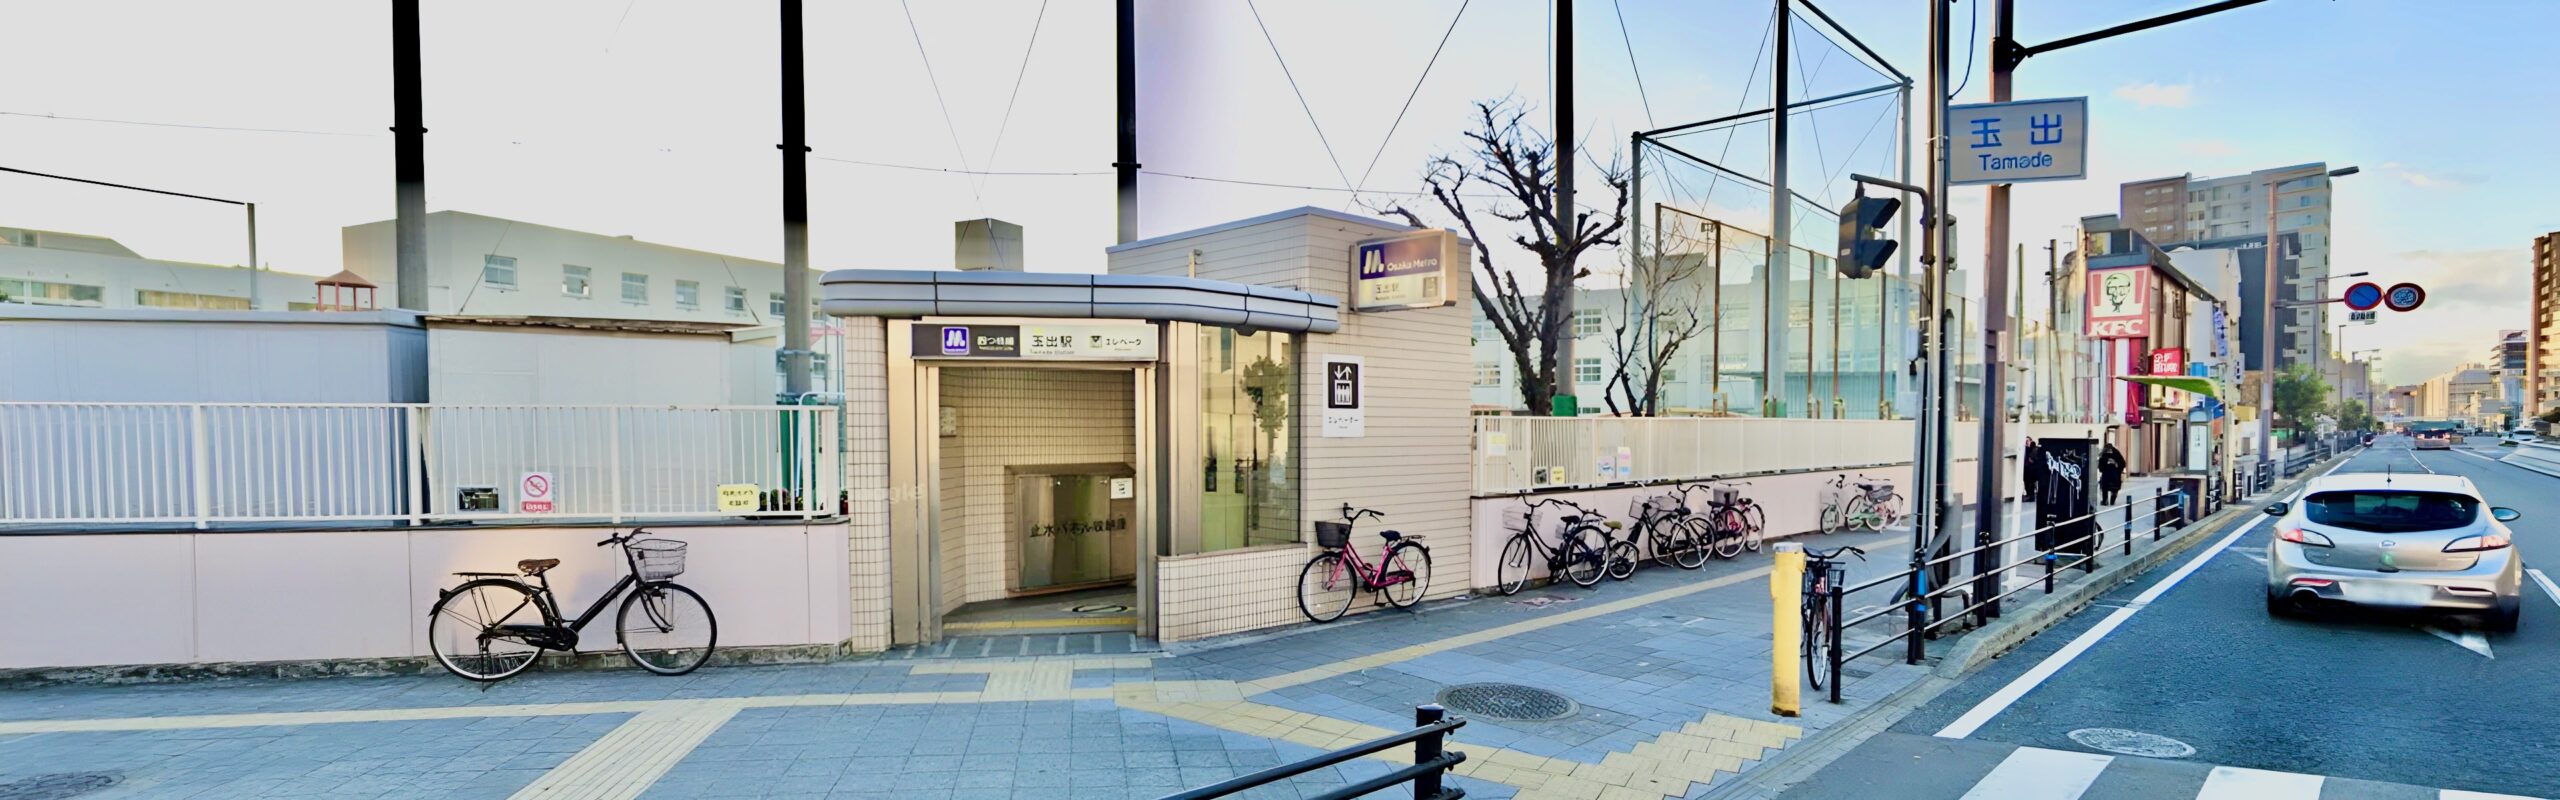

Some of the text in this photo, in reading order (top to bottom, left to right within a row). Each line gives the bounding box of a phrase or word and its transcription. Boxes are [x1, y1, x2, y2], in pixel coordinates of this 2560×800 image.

[1970, 113, 2063, 149] 玉出
[1978, 151, 2053, 171] Tamade
[1387, 258, 1438, 271] Osaka Metro
[2087, 319, 2144, 336] KFC
[1032, 335, 1073, 348] 玉出駅
